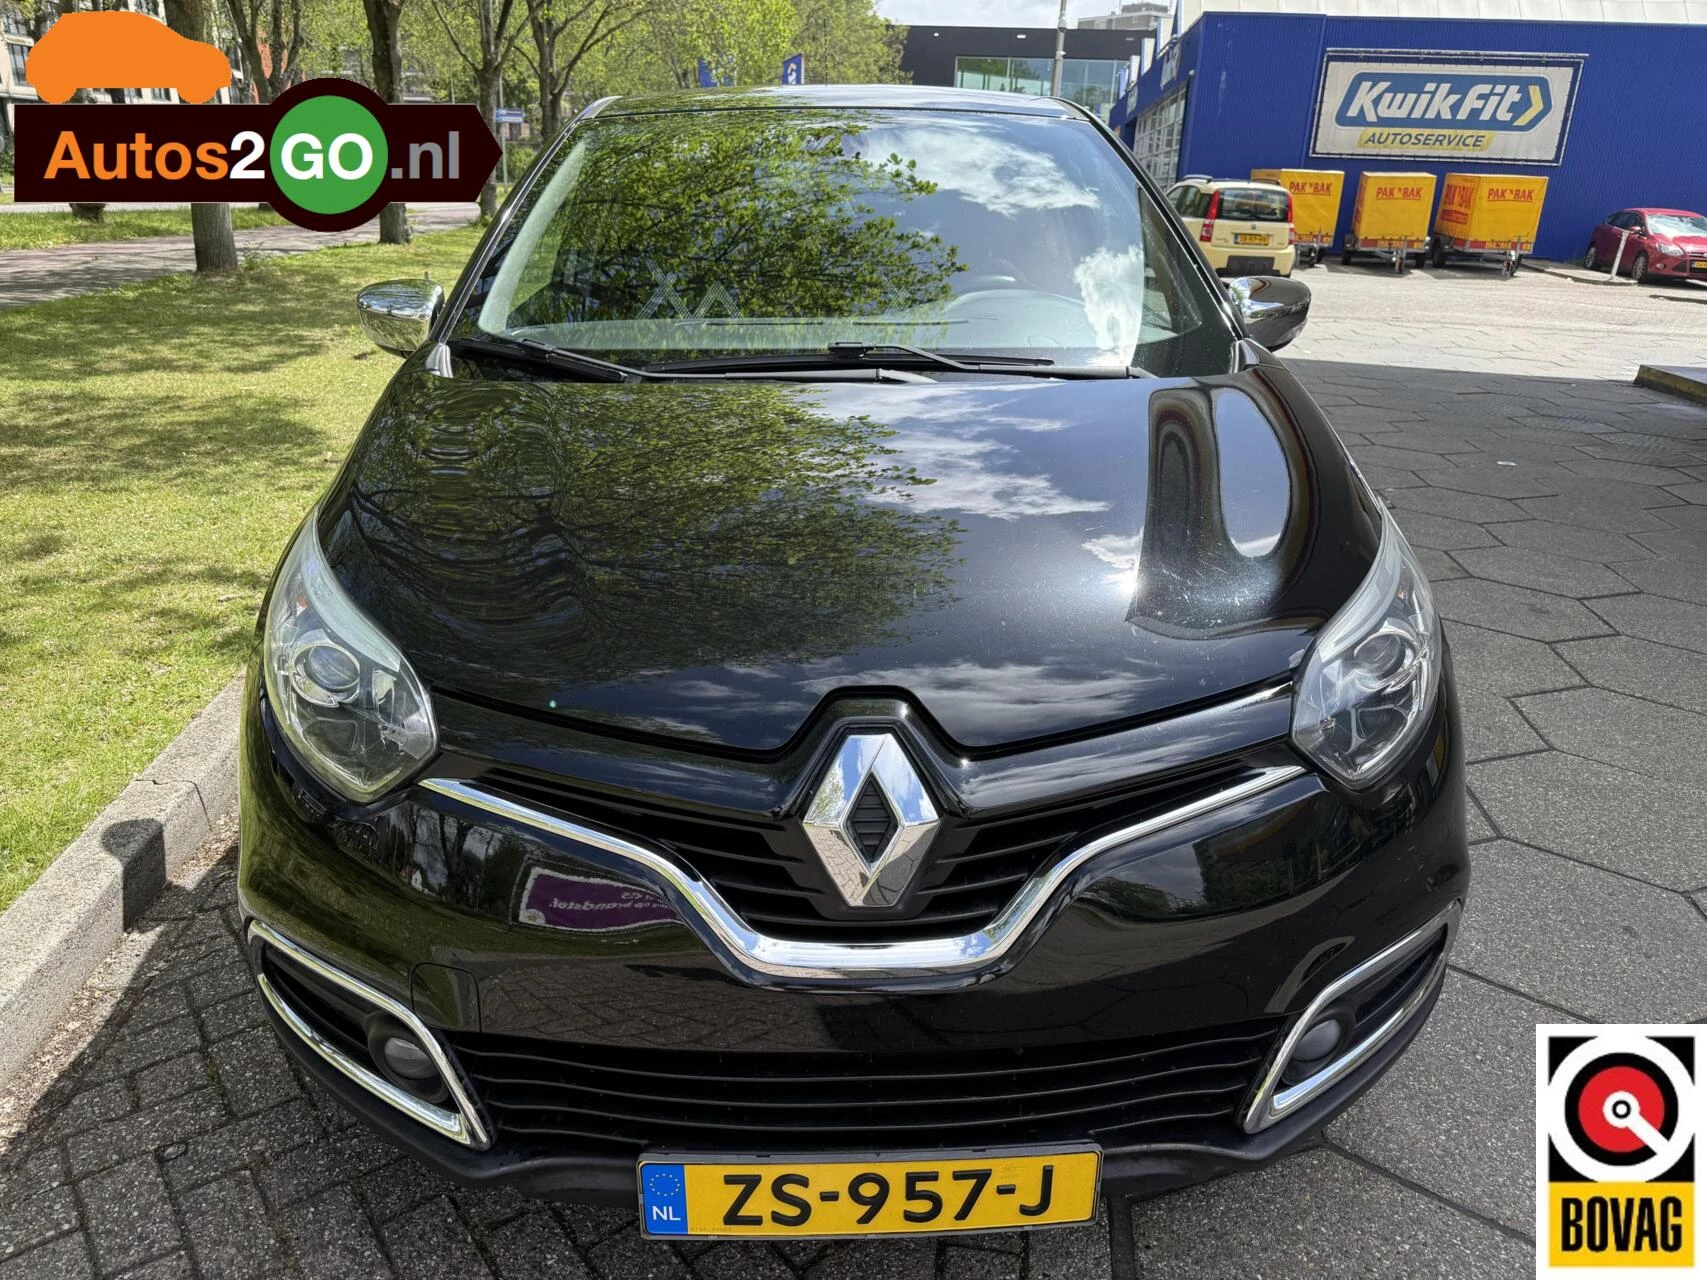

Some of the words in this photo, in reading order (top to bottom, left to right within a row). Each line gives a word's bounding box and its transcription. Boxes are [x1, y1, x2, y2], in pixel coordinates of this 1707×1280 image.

[1364, 132, 1486, 148] AUTOSERVICE
[1289, 182, 1308, 193] PAK
[1313, 183, 1332, 194] BAK
[1376, 186, 1395, 198] PAK
[1402, 187, 1423, 198] BAK
[1487, 188, 1507, 200] PAK
[1513, 188, 1533, 201] BAK
[652, 1205, 681, 1222] NL
[722, 1164, 1055, 1227] ZS-957-J
